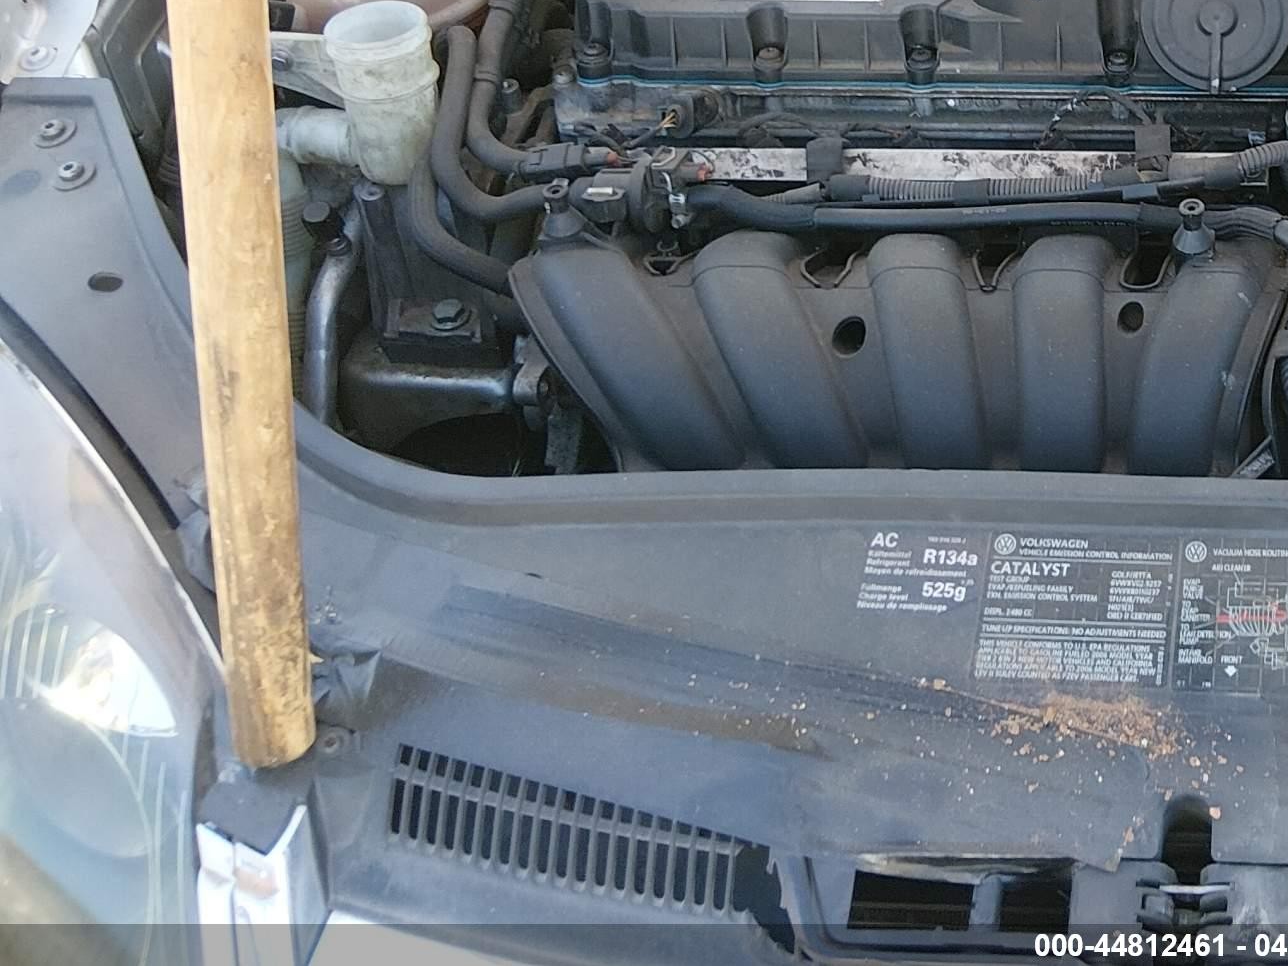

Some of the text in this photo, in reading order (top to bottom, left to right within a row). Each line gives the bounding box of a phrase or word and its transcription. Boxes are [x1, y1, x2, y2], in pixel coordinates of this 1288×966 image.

[870, 532, 899, 548] AC
[1020, 538, 1088, 549] VOLKSWAGEN
[923, 548, 978, 566] R134a
[1086, 550, 1119, 559] CONTROL
[1121, 552, 1173, 560] INFORMATION
[1213, 548, 1243, 556] VACUUM
[1244, 549, 1261, 557] HOSE
[991, 561, 1070, 577] CATALYST
[922, 581, 966, 602] 525g
[1221, 655, 1243, 664] FRONT
